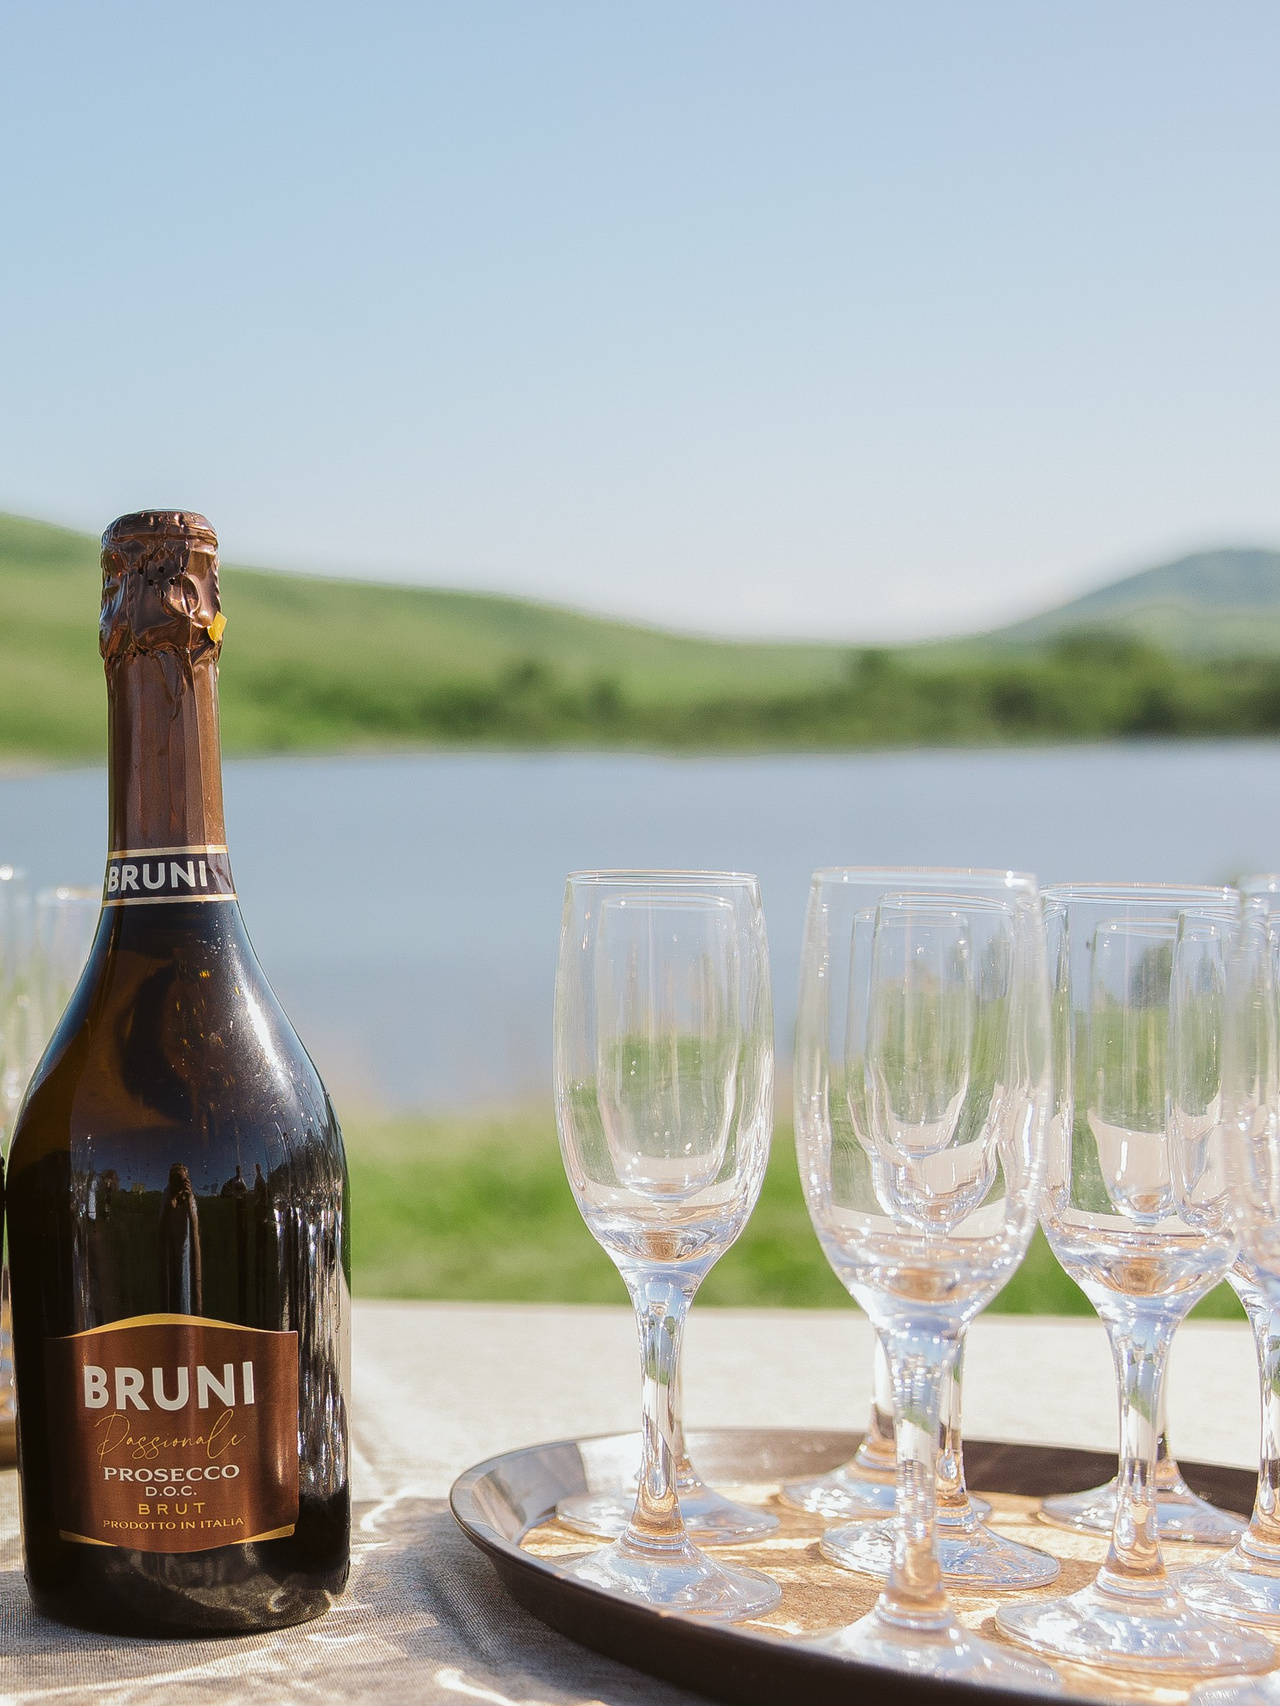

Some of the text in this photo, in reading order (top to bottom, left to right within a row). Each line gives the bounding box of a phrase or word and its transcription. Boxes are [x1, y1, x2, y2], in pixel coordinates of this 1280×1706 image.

[107, 861, 208, 893] BRUNI
[83, 1361, 255, 1411] BRUNI
[93, 1408, 246, 1469] Passionale
[102, 1464, 240, 1483] PROSECCO
[145, 1485, 197, 1497] D.O.C.
[138, 1502, 205, 1515] BRUT
[103, 1517, 244, 1530] PRODOTTO IN ITALIA
